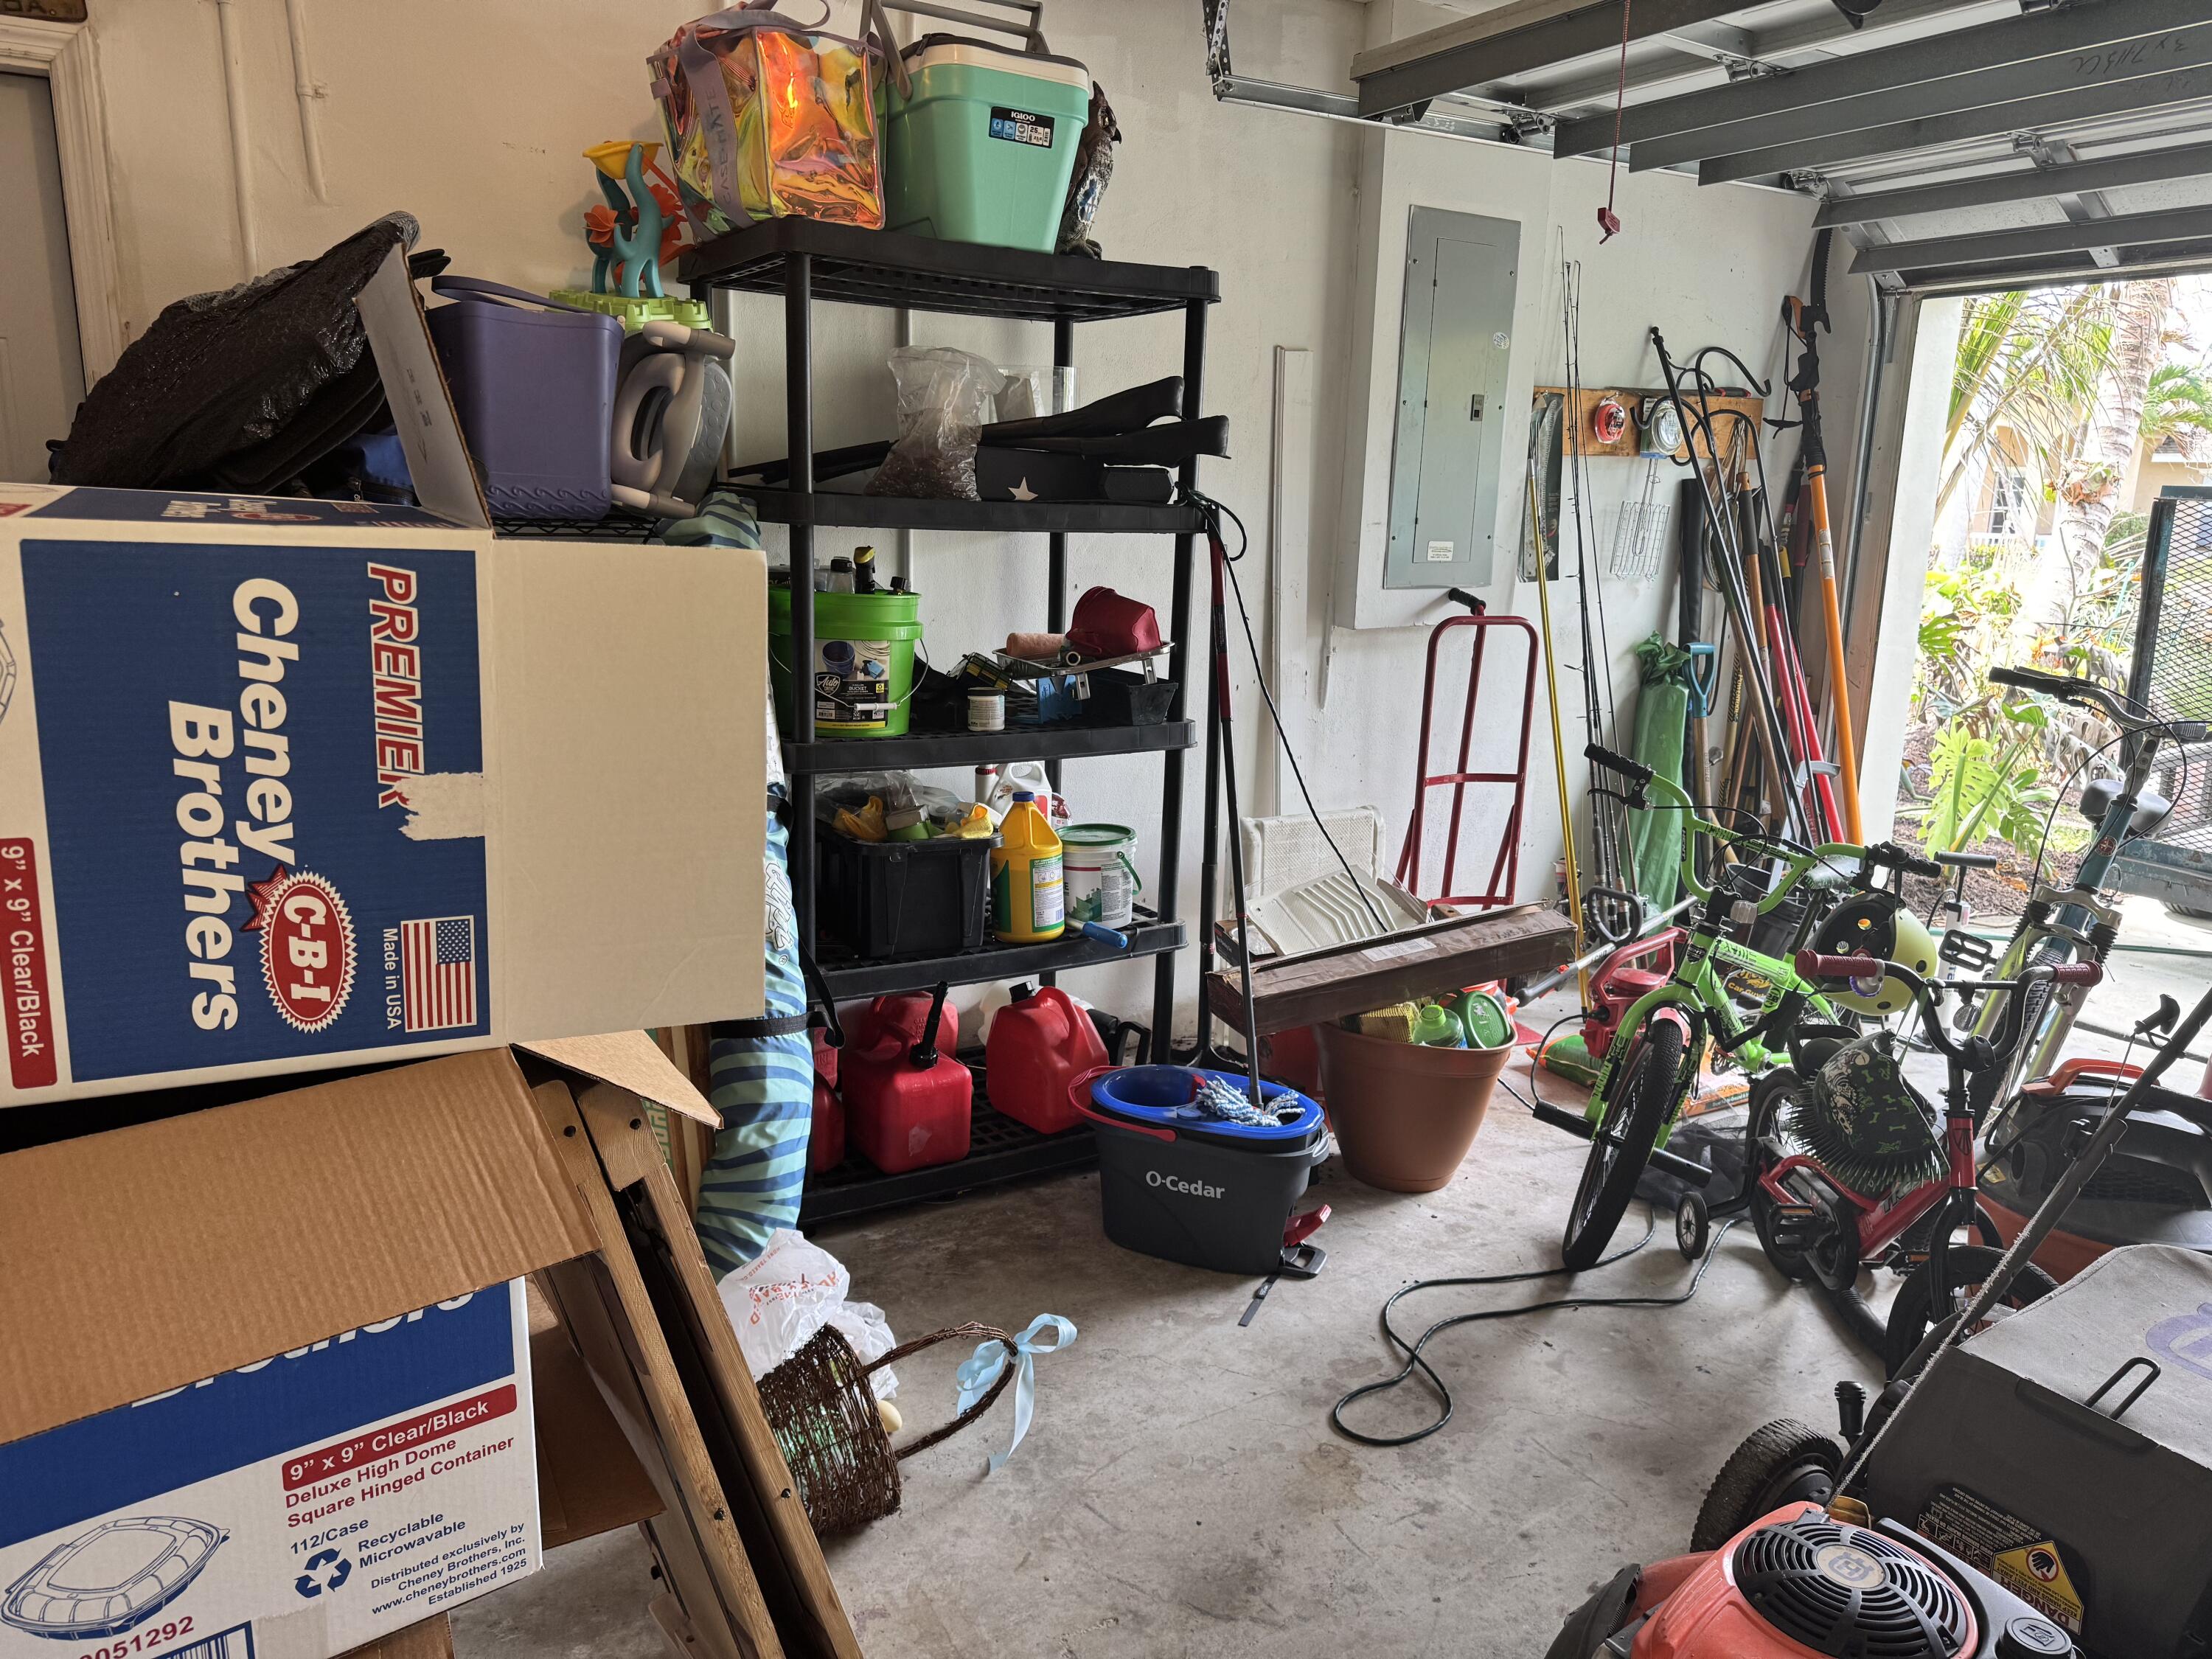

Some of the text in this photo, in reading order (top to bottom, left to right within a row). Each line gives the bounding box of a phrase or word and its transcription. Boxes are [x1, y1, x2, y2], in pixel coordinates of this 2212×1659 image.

[1011, 111, 1036, 122] IGLOO
[367, 561, 425, 809] PREMIER
[233, 578, 299, 866] Cheney
[4, 878, 23, 891] x
[168, 700, 244, 1031] Brothers
[284, 895, 330, 1002] C-B-I
[383, 928, 403, 1030] Made in USA
[10, 930, 44, 1057] Clear/Black
[1145, 1169, 1225, 1200] O-Cedar
[321, 1456, 336, 1472] x
[372, 1399, 490, 1453] Clear/Black
[285, 1437, 457, 1509] Deluxe High Dome
[287, 1435, 515, 1529] Square Hinged Container
[290, 1517, 370, 1555] 112/Case
[358, 1513, 444, 1553] Recyclable
[359, 1520, 467, 1569] Microwavable
[371, 1523, 525, 1589] Distributed exclusively by
[397, 1536, 526, 1591] Cheney Brothers, Inc.
[372, 1548, 526, 1615] www.cheneybrothers.com
[428, 1558, 527, 1605] Established 1925
[1997, 1566, 2076, 1618] KEEP HANDS AND FEET AWAY
[2000, 1576, 2069, 1626] DANGER
